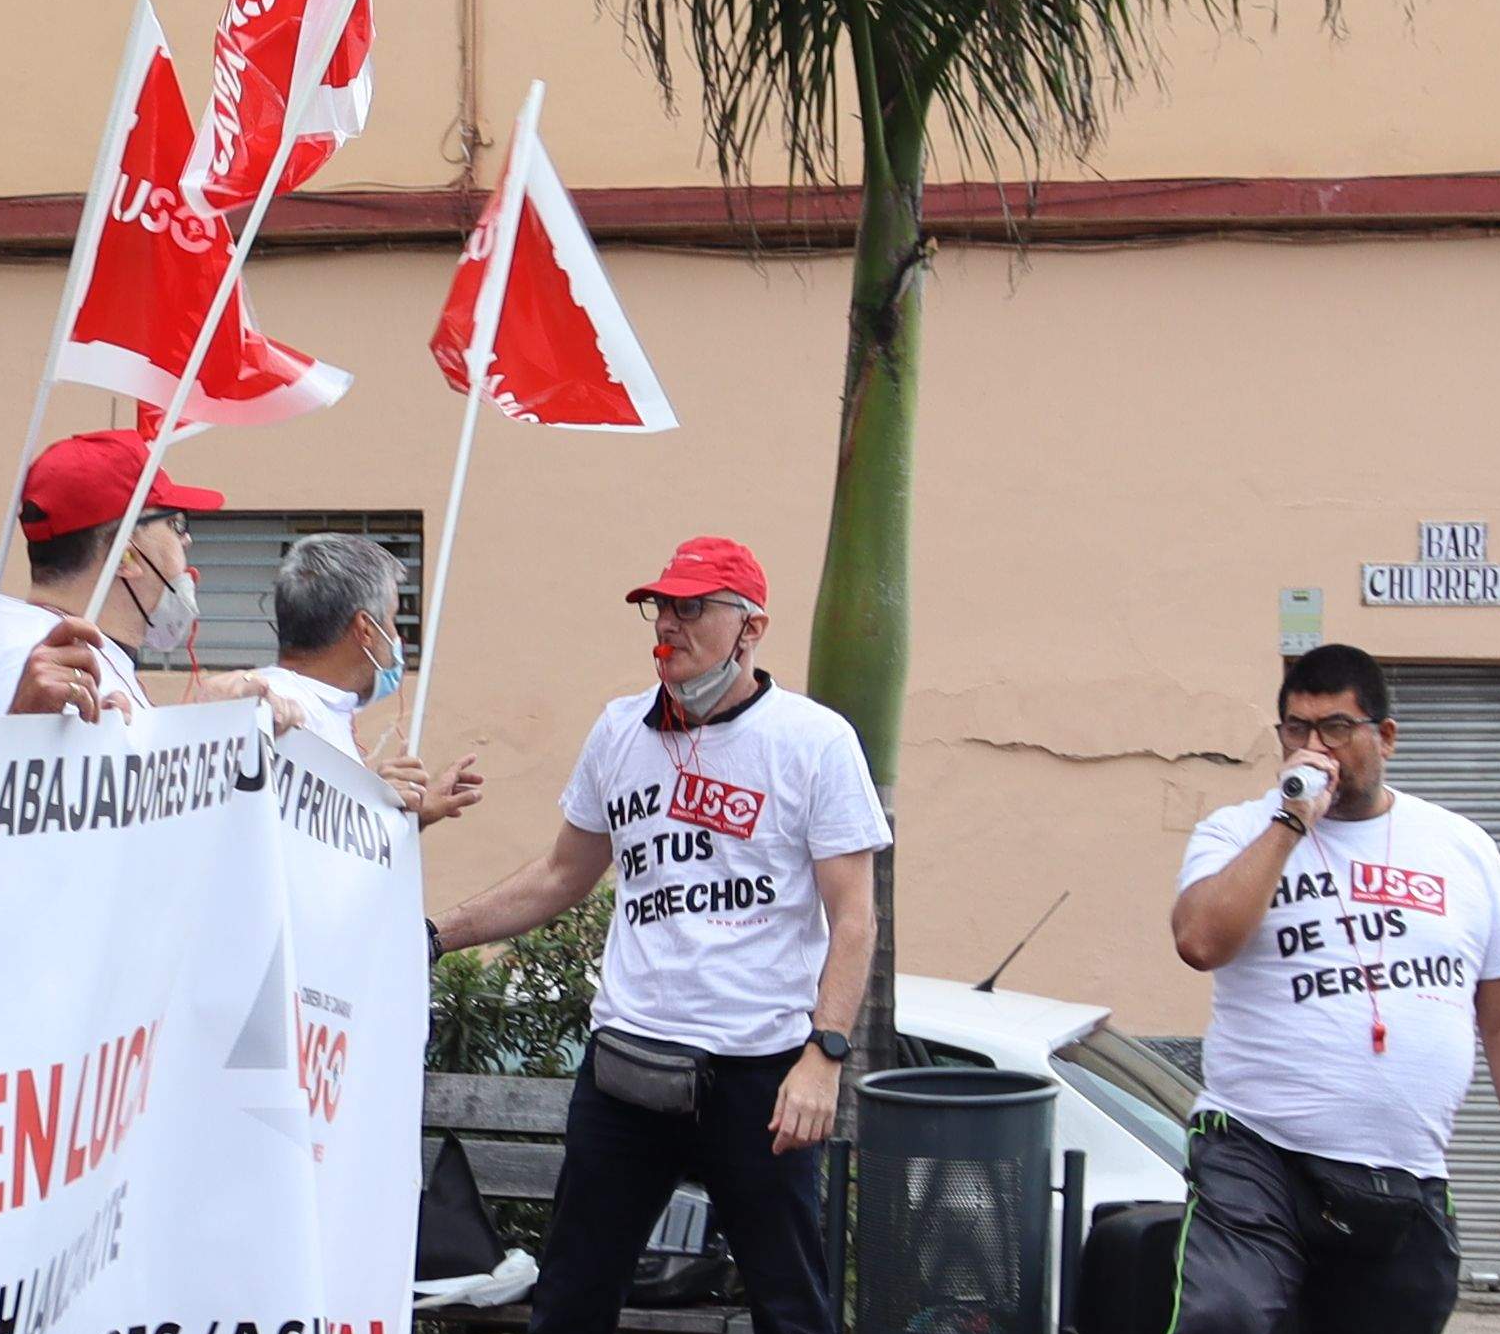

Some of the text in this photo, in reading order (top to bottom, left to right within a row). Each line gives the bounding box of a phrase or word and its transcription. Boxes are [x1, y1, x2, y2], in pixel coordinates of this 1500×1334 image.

[1426, 526, 1481, 561] BAR
[191, 740, 219, 811] DE
[295, 770, 393, 870] PRIVADA
[607, 775, 759, 831] HAZ USO
[621, 830, 714, 882] DE TUS
[625, 875, 776, 926] DERECHOS
[1270, 872, 1339, 909] HAZ
[1352, 862, 1444, 905] USO
[1277, 908, 1407, 958] DE TUS
[1291, 955, 1465, 1004] DERECHOS
